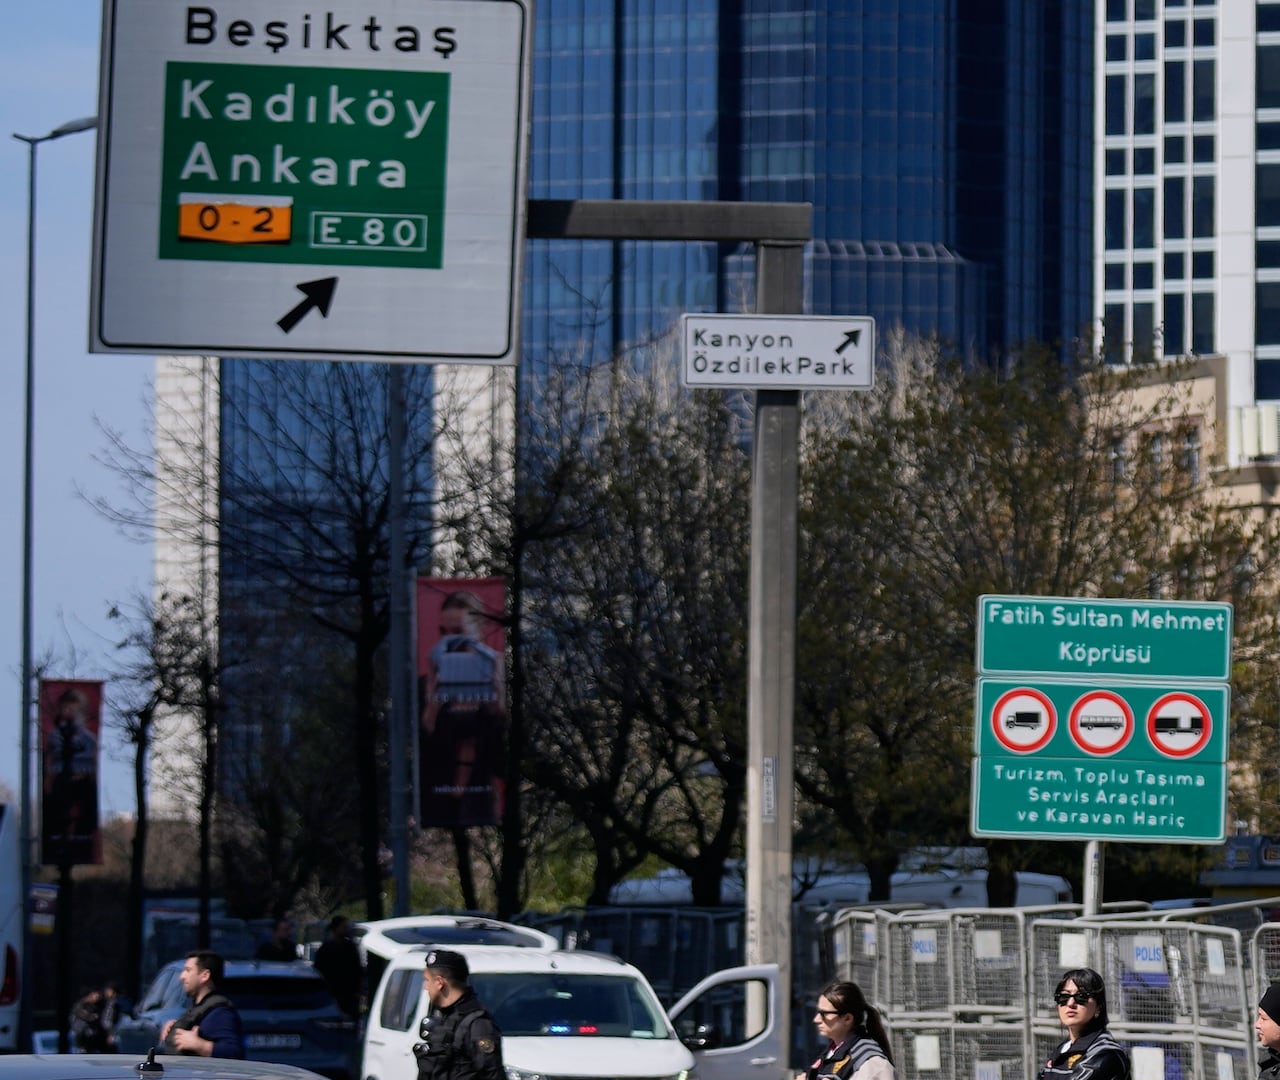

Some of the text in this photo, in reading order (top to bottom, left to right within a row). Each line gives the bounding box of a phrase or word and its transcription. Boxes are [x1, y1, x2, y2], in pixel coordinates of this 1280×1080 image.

[186, 6, 458, 59] Beşiktaş
[180, 79, 436, 139] Kadıköy
[179, 141, 407, 188] Ankara
[694, 329, 793, 351] Kanyon
[988, 603, 1225, 631] Fatih Sultan Mehmet
[1059, 641, 1151, 666] Köprüsü
[1074, 767, 1129, 785] Toplu
[1136, 769, 1206, 786] Taşıma
[1028, 787, 1175, 806] Servis Araçları
[1017, 808, 1186, 828] ve Karavan Hariç
[1134, 945, 1162, 961] POLİS
